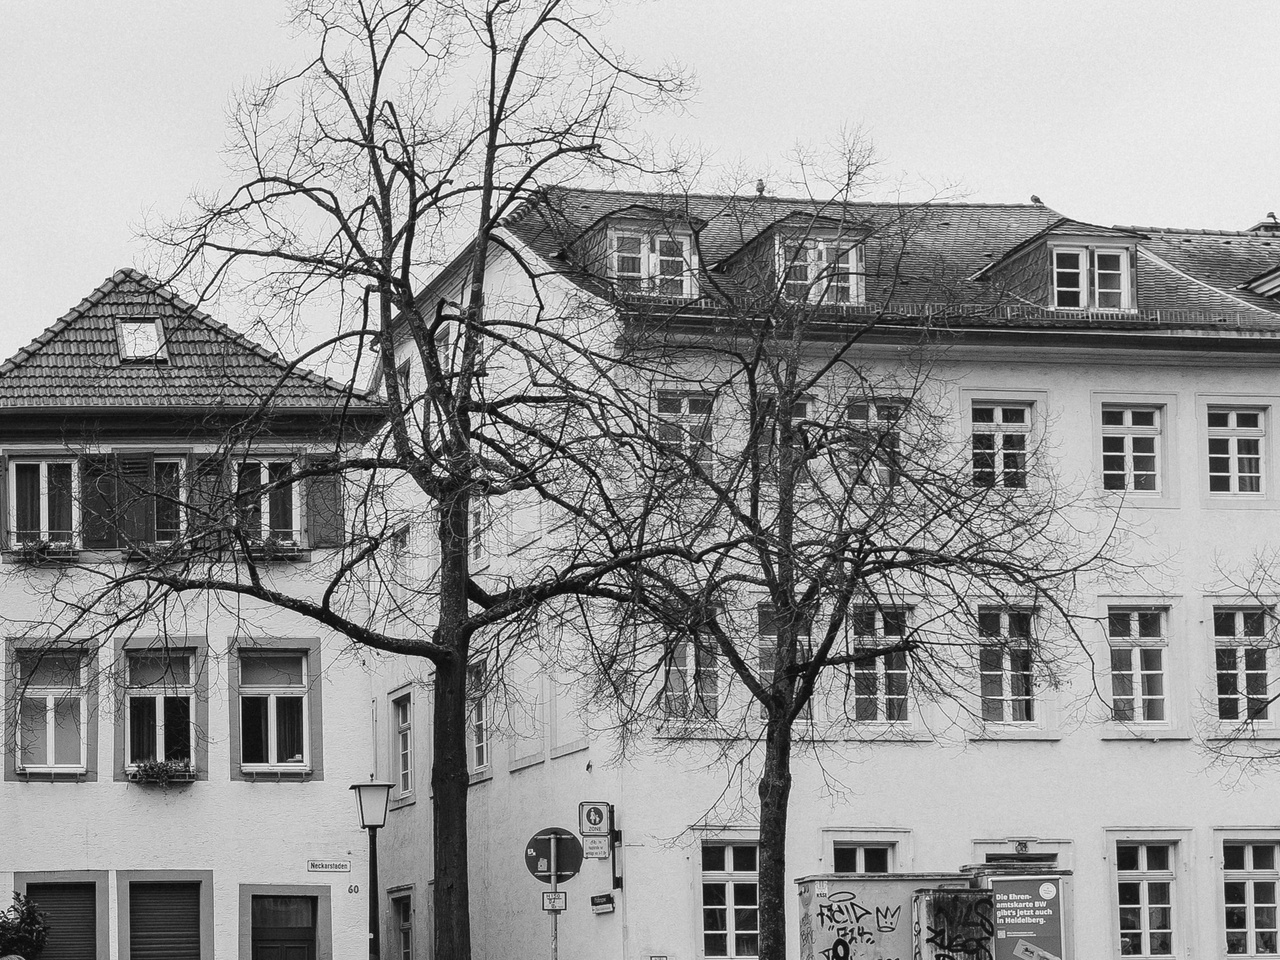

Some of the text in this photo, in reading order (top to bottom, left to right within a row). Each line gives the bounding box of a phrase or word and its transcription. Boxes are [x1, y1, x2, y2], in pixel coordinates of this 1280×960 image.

[310, 862, 348, 870] Neckarstaden
[347, 885, 360, 894] 60
[1017, 909, 1034, 917] jetzt
[1005, 917, 1047, 925] Heidelberg.
